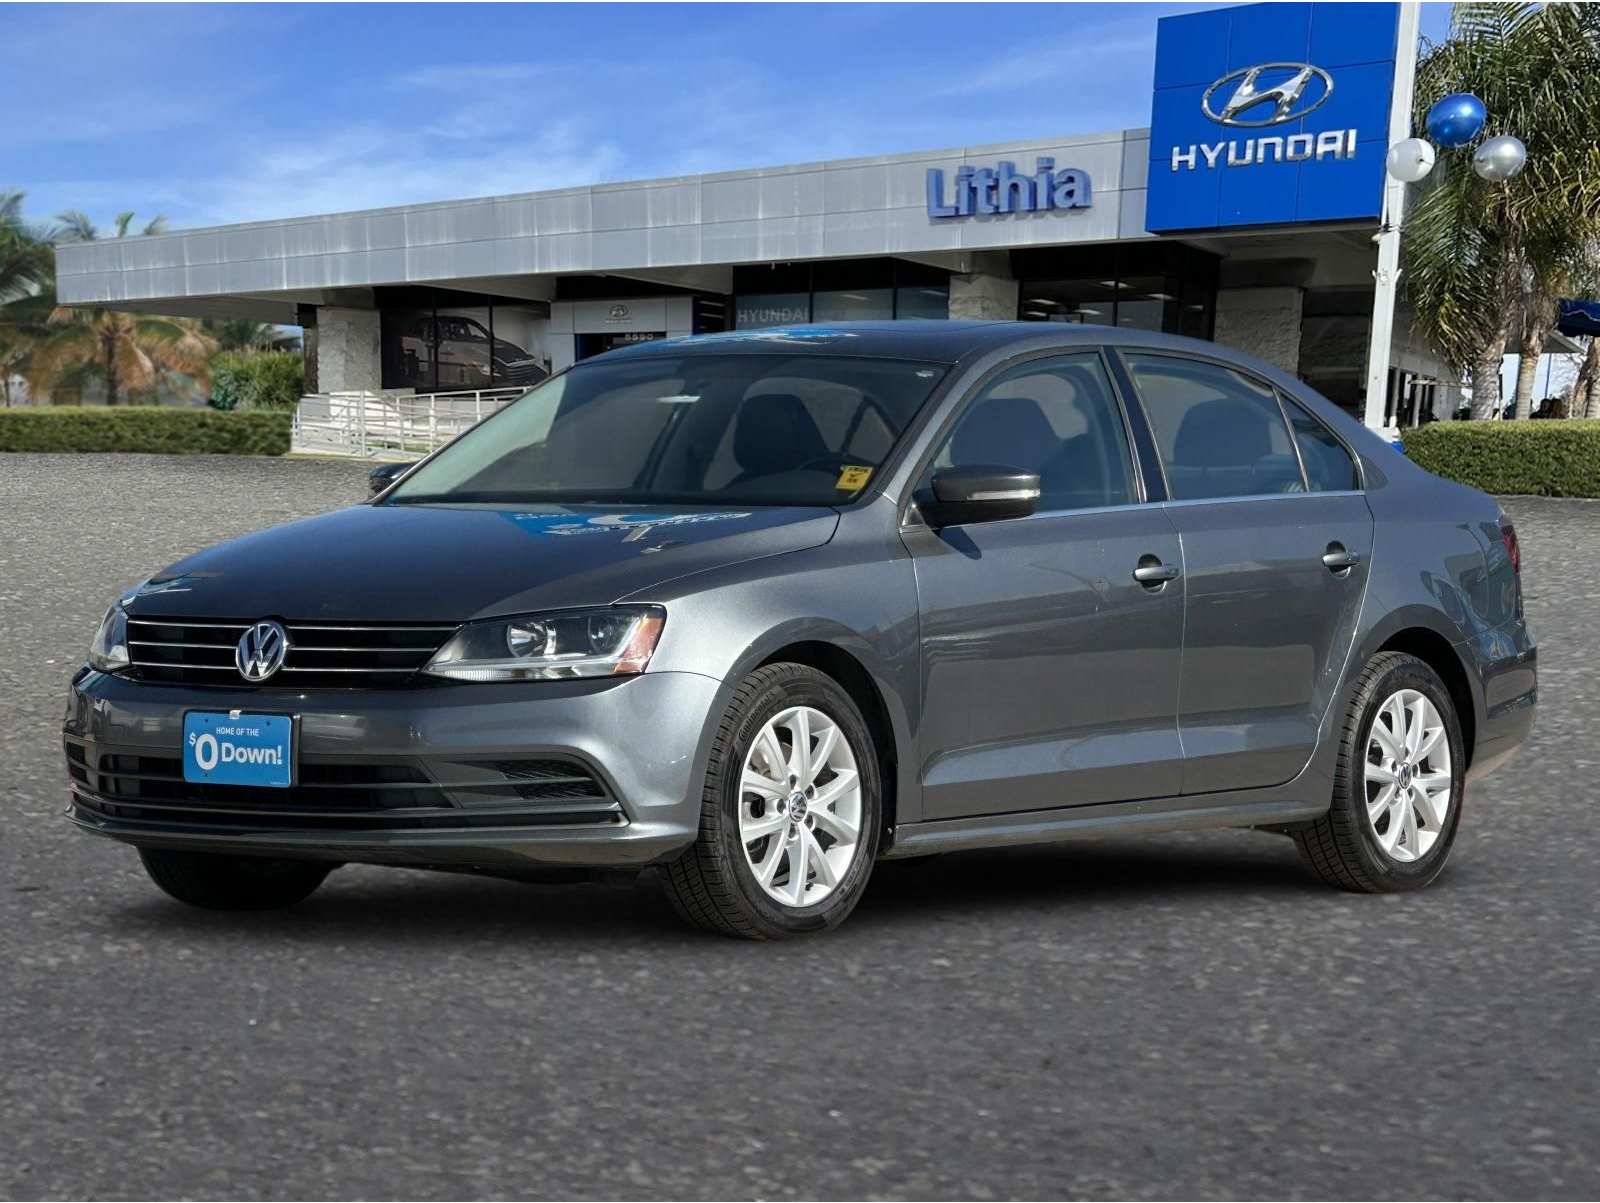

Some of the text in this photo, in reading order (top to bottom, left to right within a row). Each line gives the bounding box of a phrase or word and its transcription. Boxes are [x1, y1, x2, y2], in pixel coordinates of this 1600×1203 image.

[1171, 128, 1358, 172] HYUNDAI
[926, 157, 1093, 218] Lithia
[737, 307, 810, 322] HYUNDAI
[189, 732, 283, 770] $0 Down!
[216, 727, 260, 737] HOME OF THE
